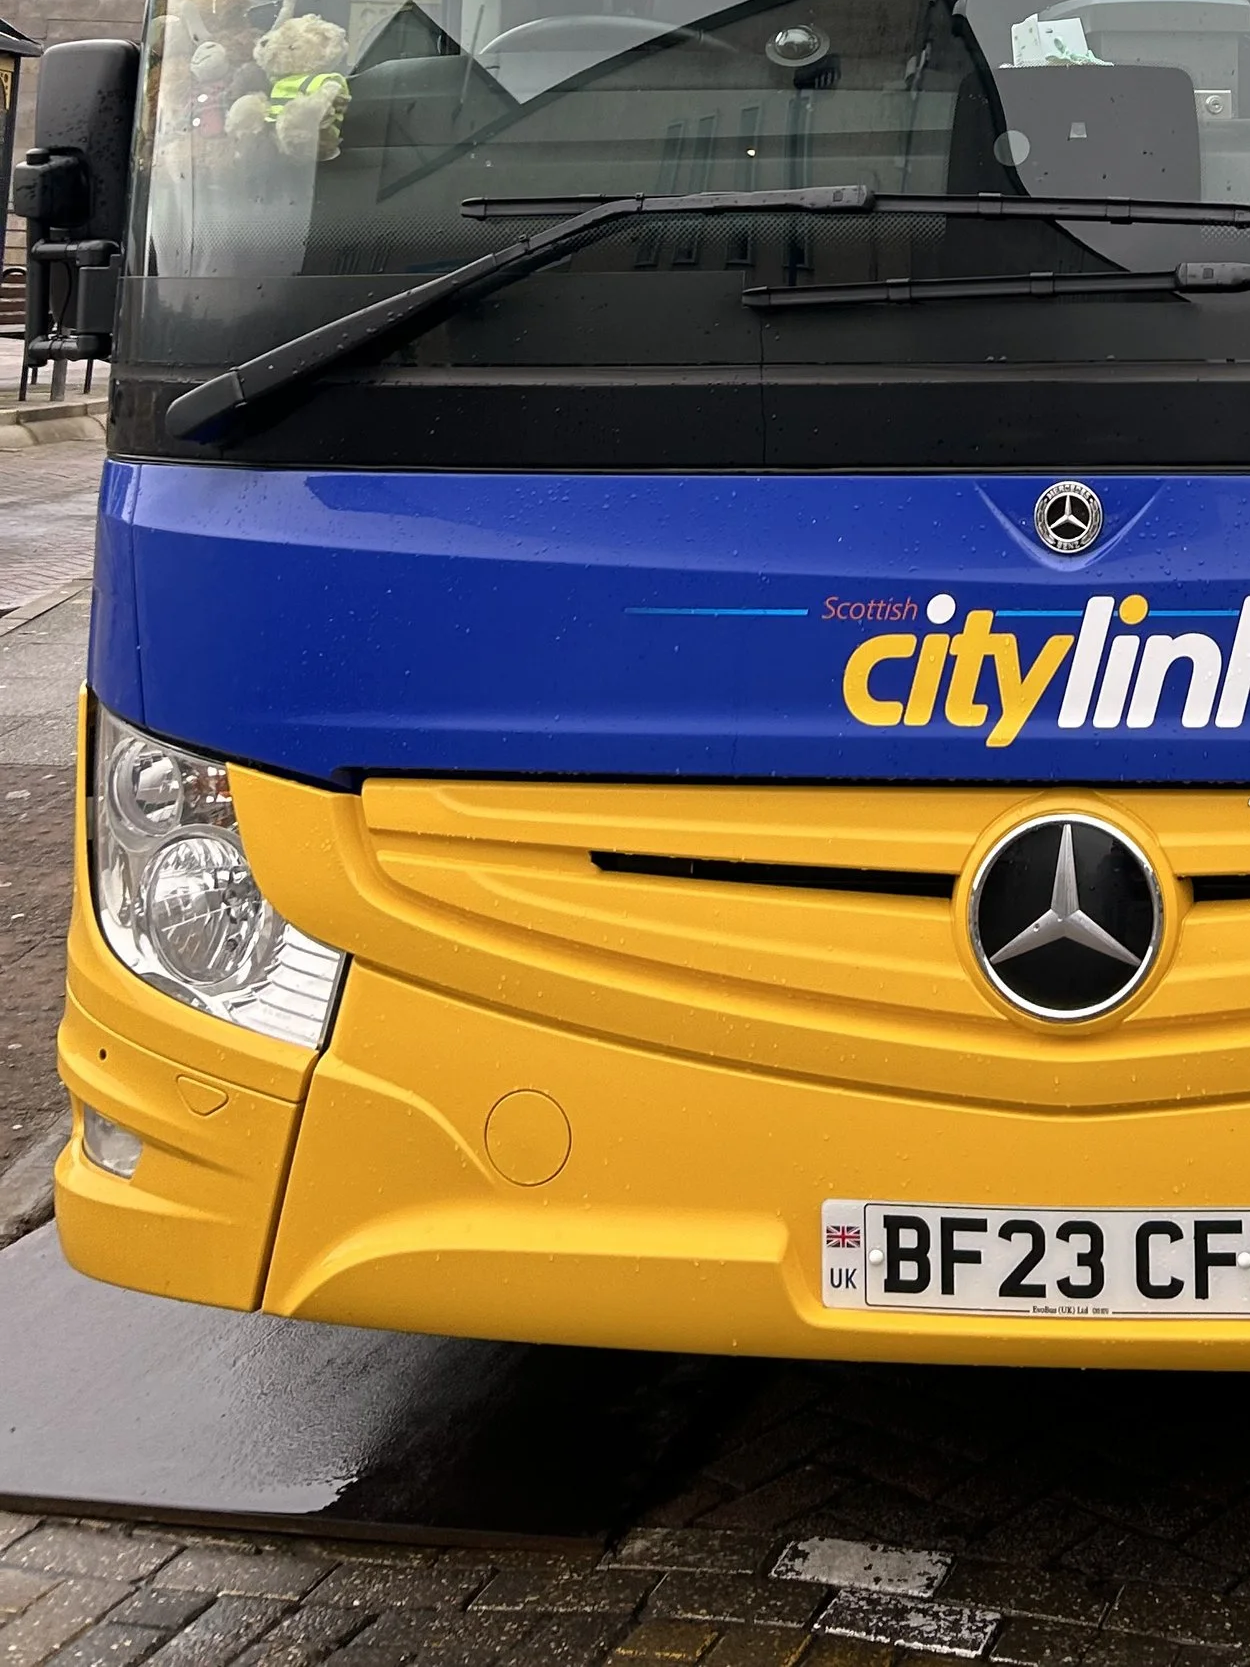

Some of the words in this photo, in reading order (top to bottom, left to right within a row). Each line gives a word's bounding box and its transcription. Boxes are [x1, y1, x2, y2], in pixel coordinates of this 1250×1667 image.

[822, 596, 918, 622] Scottish
[883, 1214, 1105, 1299] BF23
[829, 1268, 858, 1291] UK
